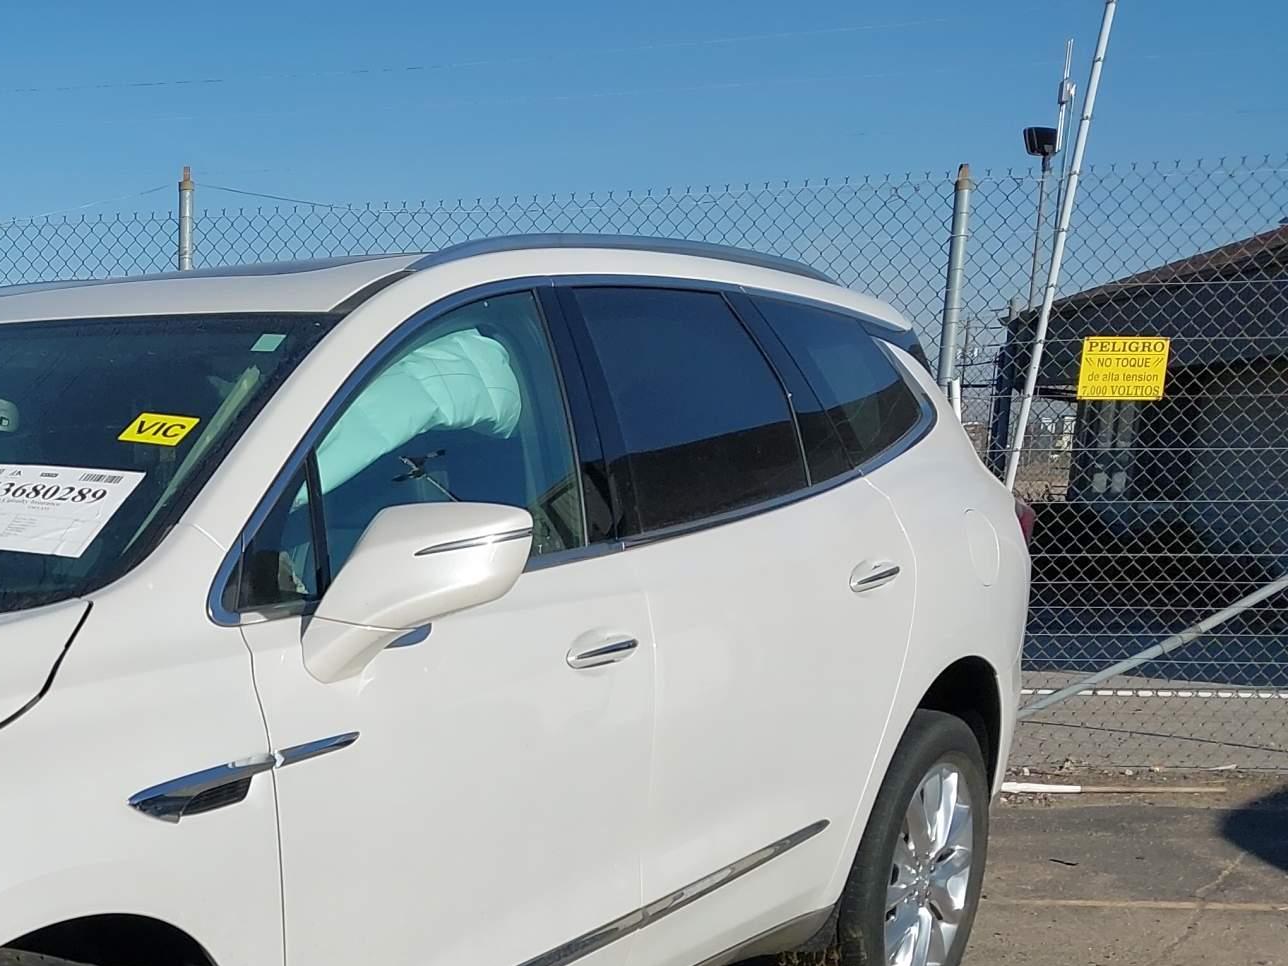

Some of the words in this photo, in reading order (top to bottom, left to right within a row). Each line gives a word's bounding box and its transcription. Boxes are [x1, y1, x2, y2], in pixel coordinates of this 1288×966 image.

[1087, 341, 1165, 353] PELIGRO
[1097, 357, 1112, 368] NO
[1116, 357, 1152, 369] TOQUE
[1087, 371, 1100, 382] de
[1102, 371, 1120, 382] alta
[1123, 371, 1159, 382] tension
[1110, 385, 1160, 396] VOLTIOS
[136, 420, 186, 438] VIC
